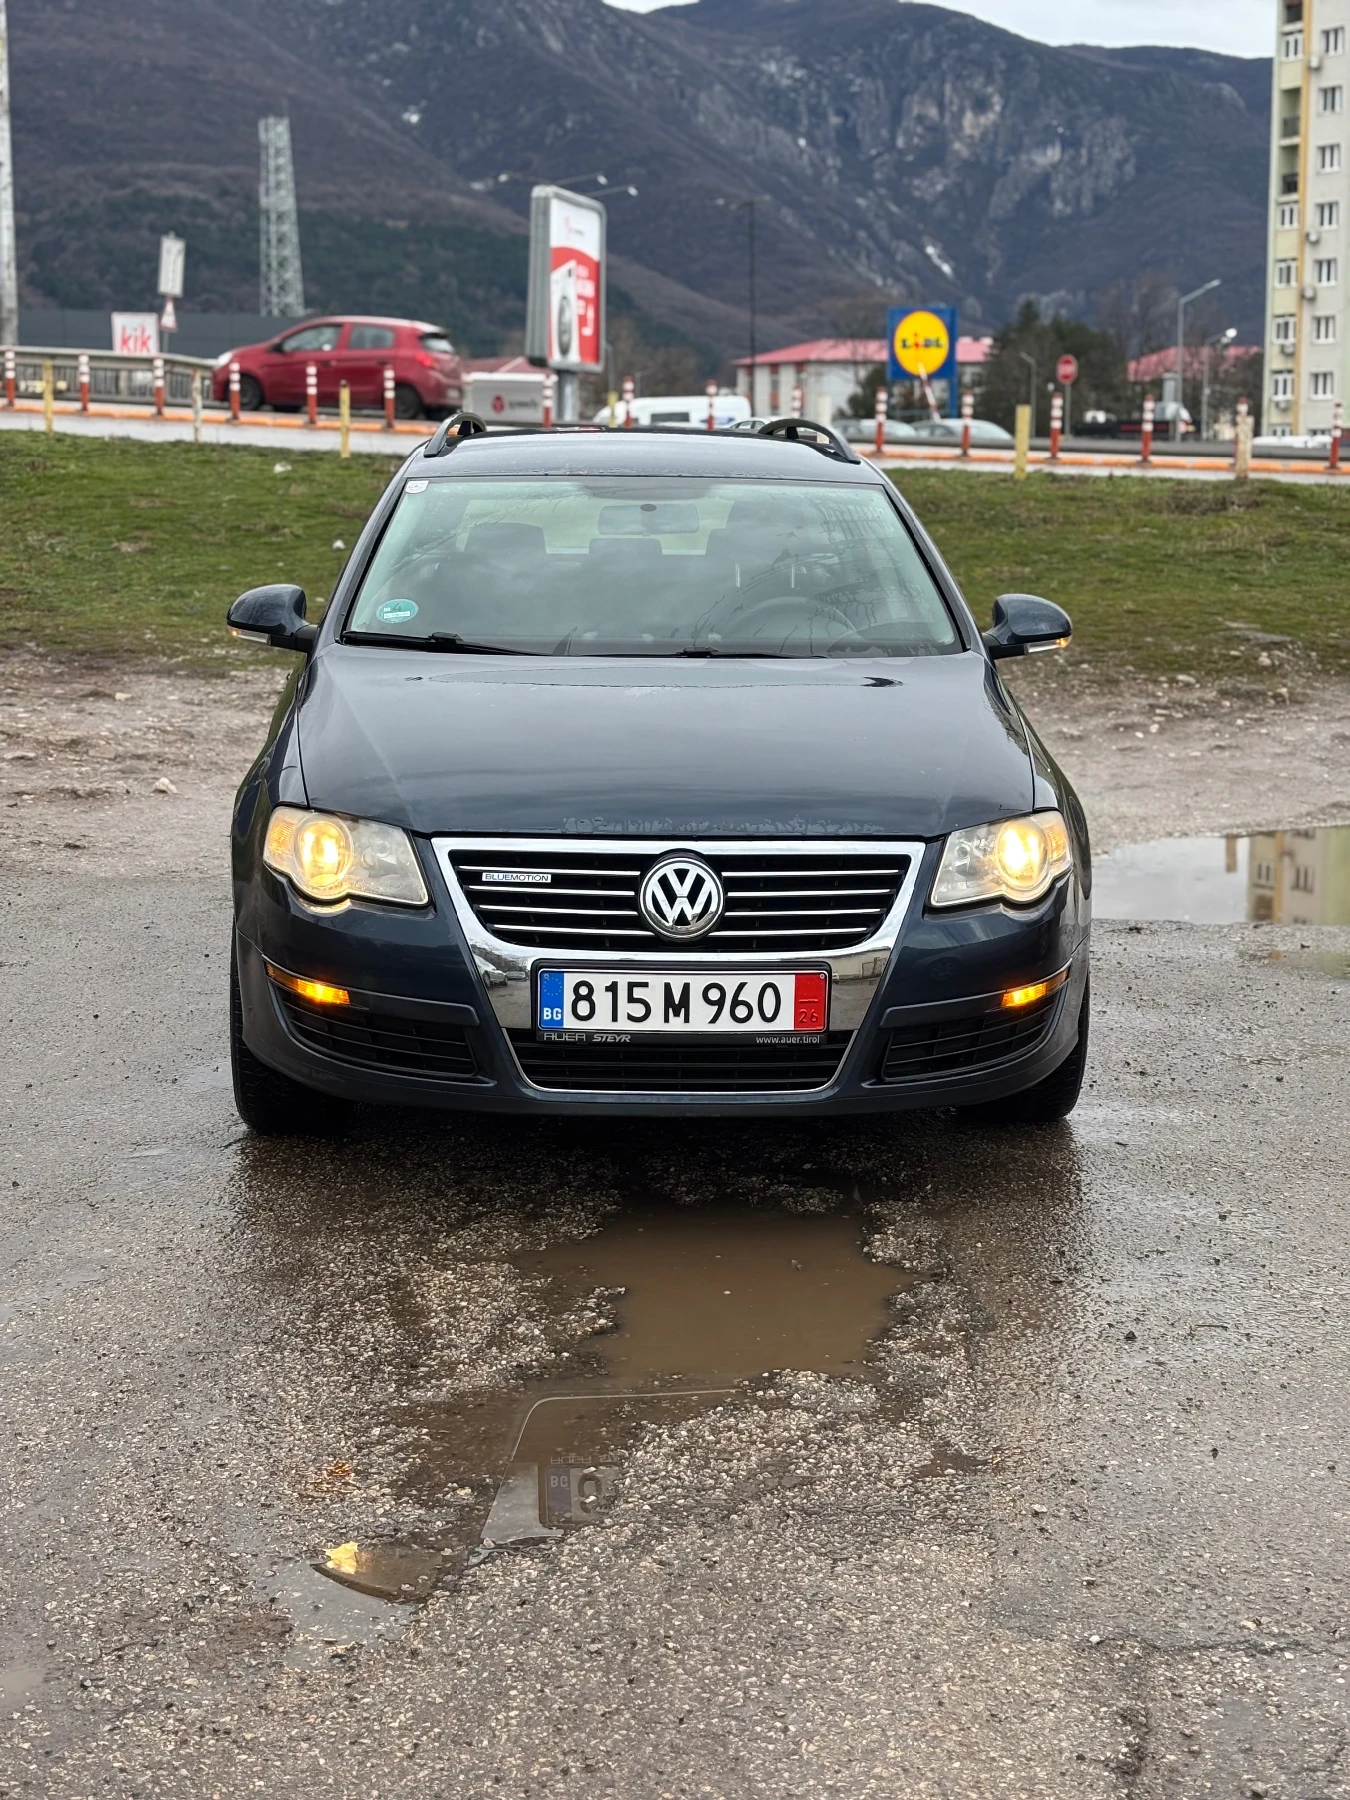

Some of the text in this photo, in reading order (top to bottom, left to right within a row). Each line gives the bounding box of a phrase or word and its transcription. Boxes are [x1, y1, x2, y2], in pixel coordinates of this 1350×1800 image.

[484, 873, 550, 882] BLUEMOTION
[571, 980, 782, 1024] 815 M 960
[543, 1007, 562, 1021] BG
[798, 1008, 819, 1023] 26
[592, 1033, 631, 1043] STEYR
[755, 1035, 820, 1044] www.auer.tirol
